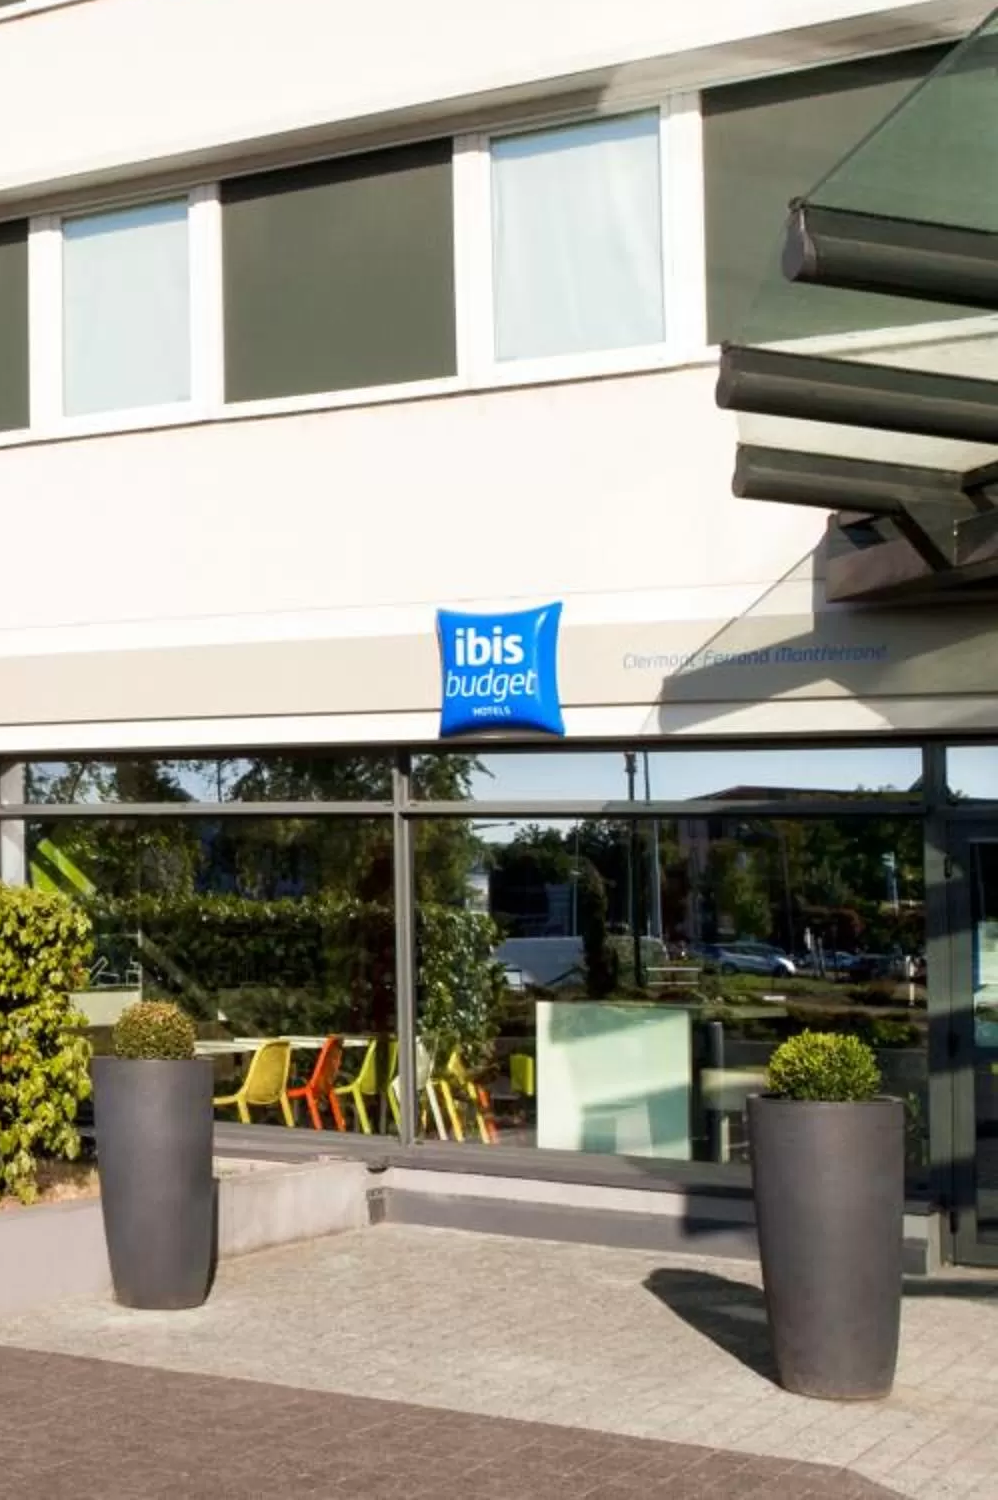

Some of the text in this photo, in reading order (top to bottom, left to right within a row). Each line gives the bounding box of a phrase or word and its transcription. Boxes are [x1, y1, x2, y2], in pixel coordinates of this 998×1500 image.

[455, 625, 524, 666] ibis
[445, 668, 537, 703] budget
[472, 705, 511, 717] HOTELS
